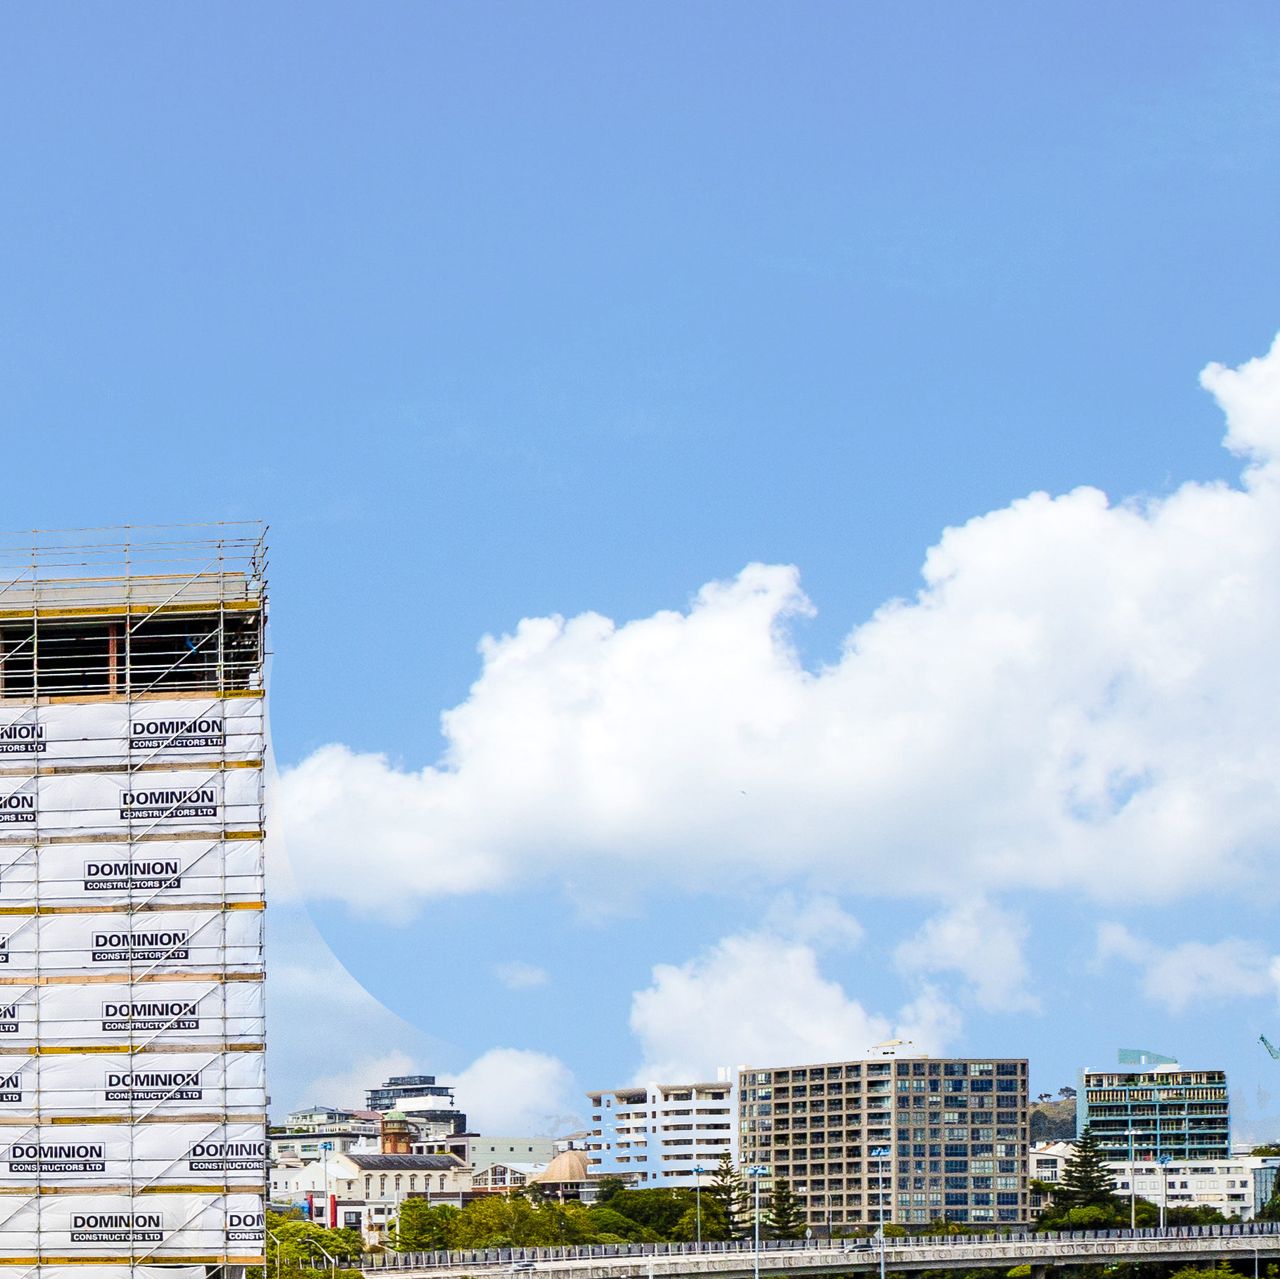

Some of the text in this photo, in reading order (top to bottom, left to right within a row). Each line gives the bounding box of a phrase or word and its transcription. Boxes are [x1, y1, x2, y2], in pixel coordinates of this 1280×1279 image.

[87, 880, 160, 889] CONSTRUCTORS
[12, 1145, 102, 1158] DOMINION
[74, 1233, 143, 1241] CONSTRUCTORS
